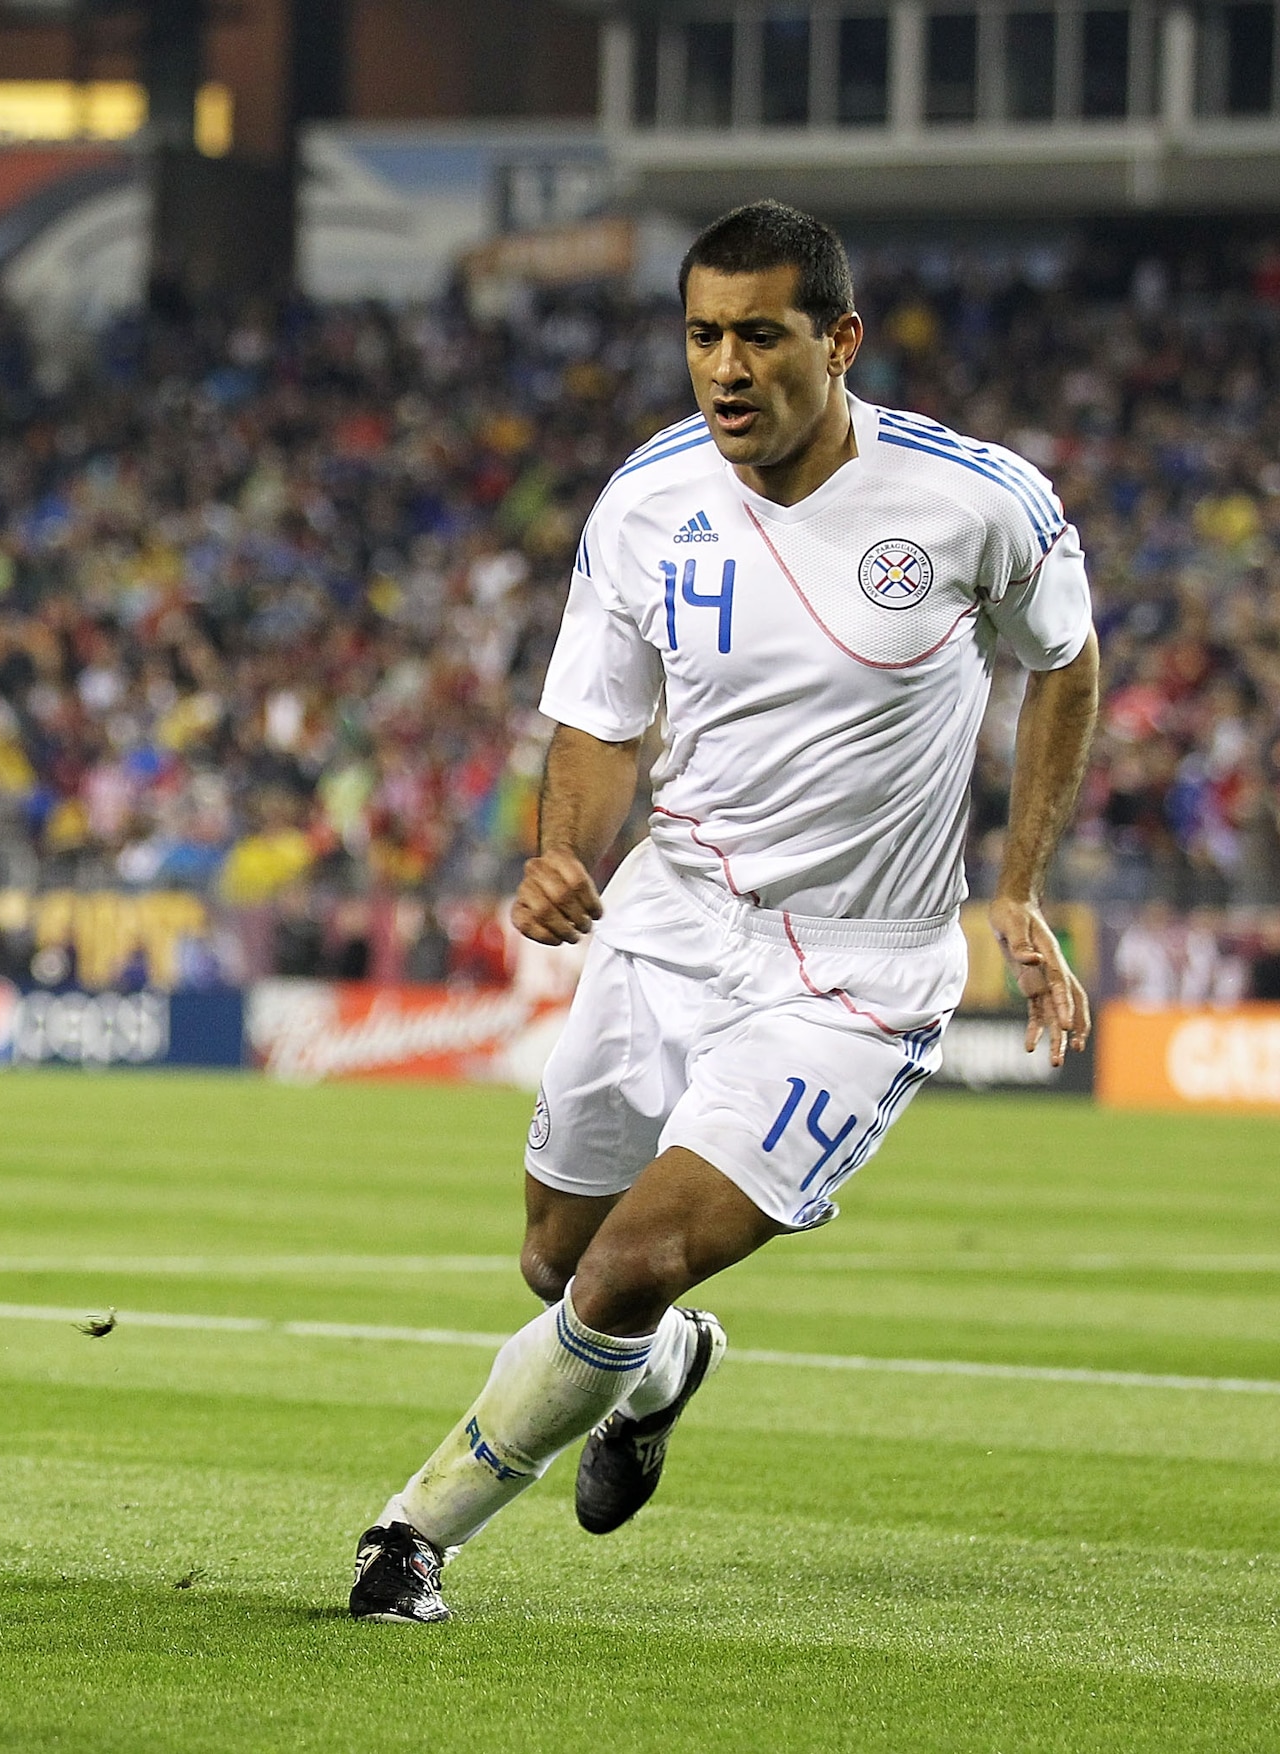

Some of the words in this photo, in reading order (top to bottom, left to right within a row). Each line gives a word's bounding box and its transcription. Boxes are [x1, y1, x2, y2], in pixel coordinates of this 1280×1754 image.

[673, 530, 719, 544] adidas
[875, 543, 918, 556] PARAGUAYA
[918, 556, 928, 568] DE
[913, 570, 929, 598] FUTBOL
[658, 558, 736, 654] 14
[762, 1077, 857, 1192] 14
[465, 1415, 527, 1481] APF
